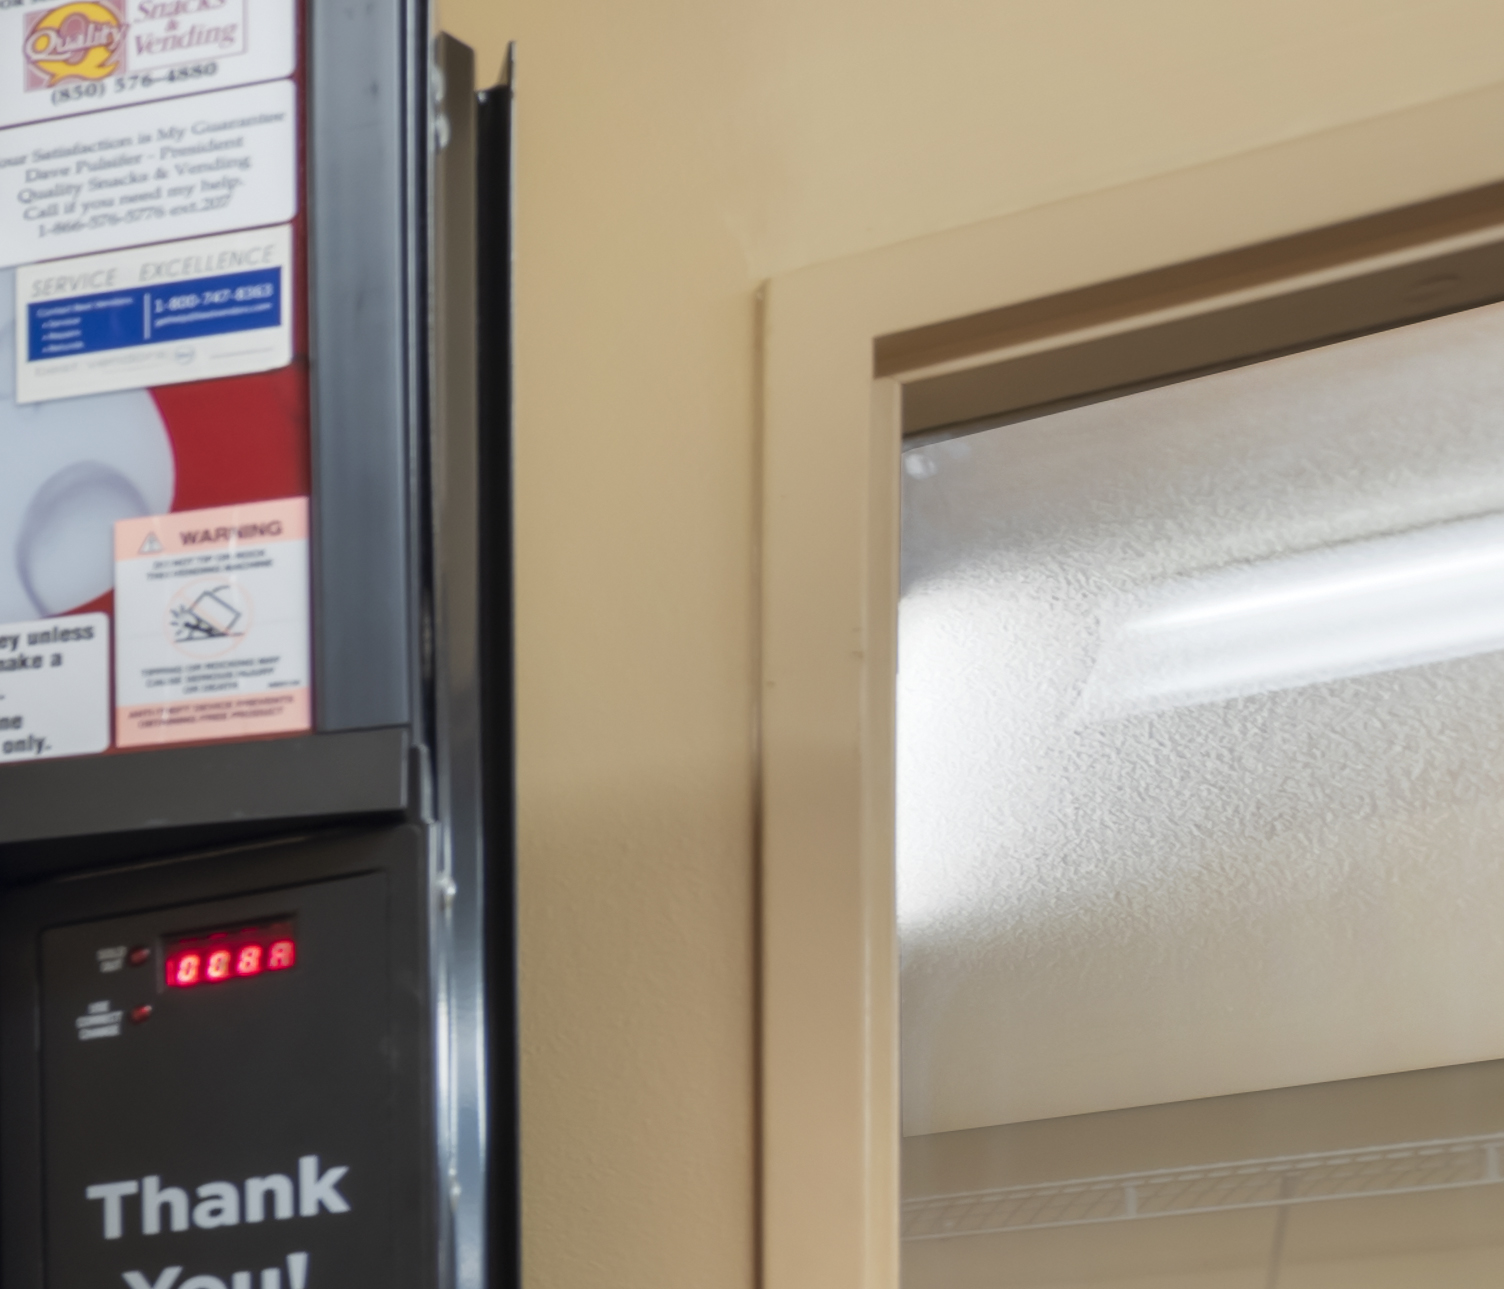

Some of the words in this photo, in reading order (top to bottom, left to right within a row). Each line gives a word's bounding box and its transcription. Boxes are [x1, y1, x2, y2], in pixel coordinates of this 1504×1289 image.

[23, 21, 129, 61] Quality
[135, 20, 238, 56] Vending
[17, 181, 82, 204] Quality
[88, 170, 148, 191] Snacks
[175, 155, 253, 178] Vending
[32, 266, 118, 299] SERVICE
[139, 243, 276, 283] EXCELLENCE
[180, 520, 283, 546] WARNING
[27, 624, 95, 646] unless
[50, 653, 63, 667] a
[1, 735, 52, 755] only.
[86, 1154, 351, 1240] Thank
